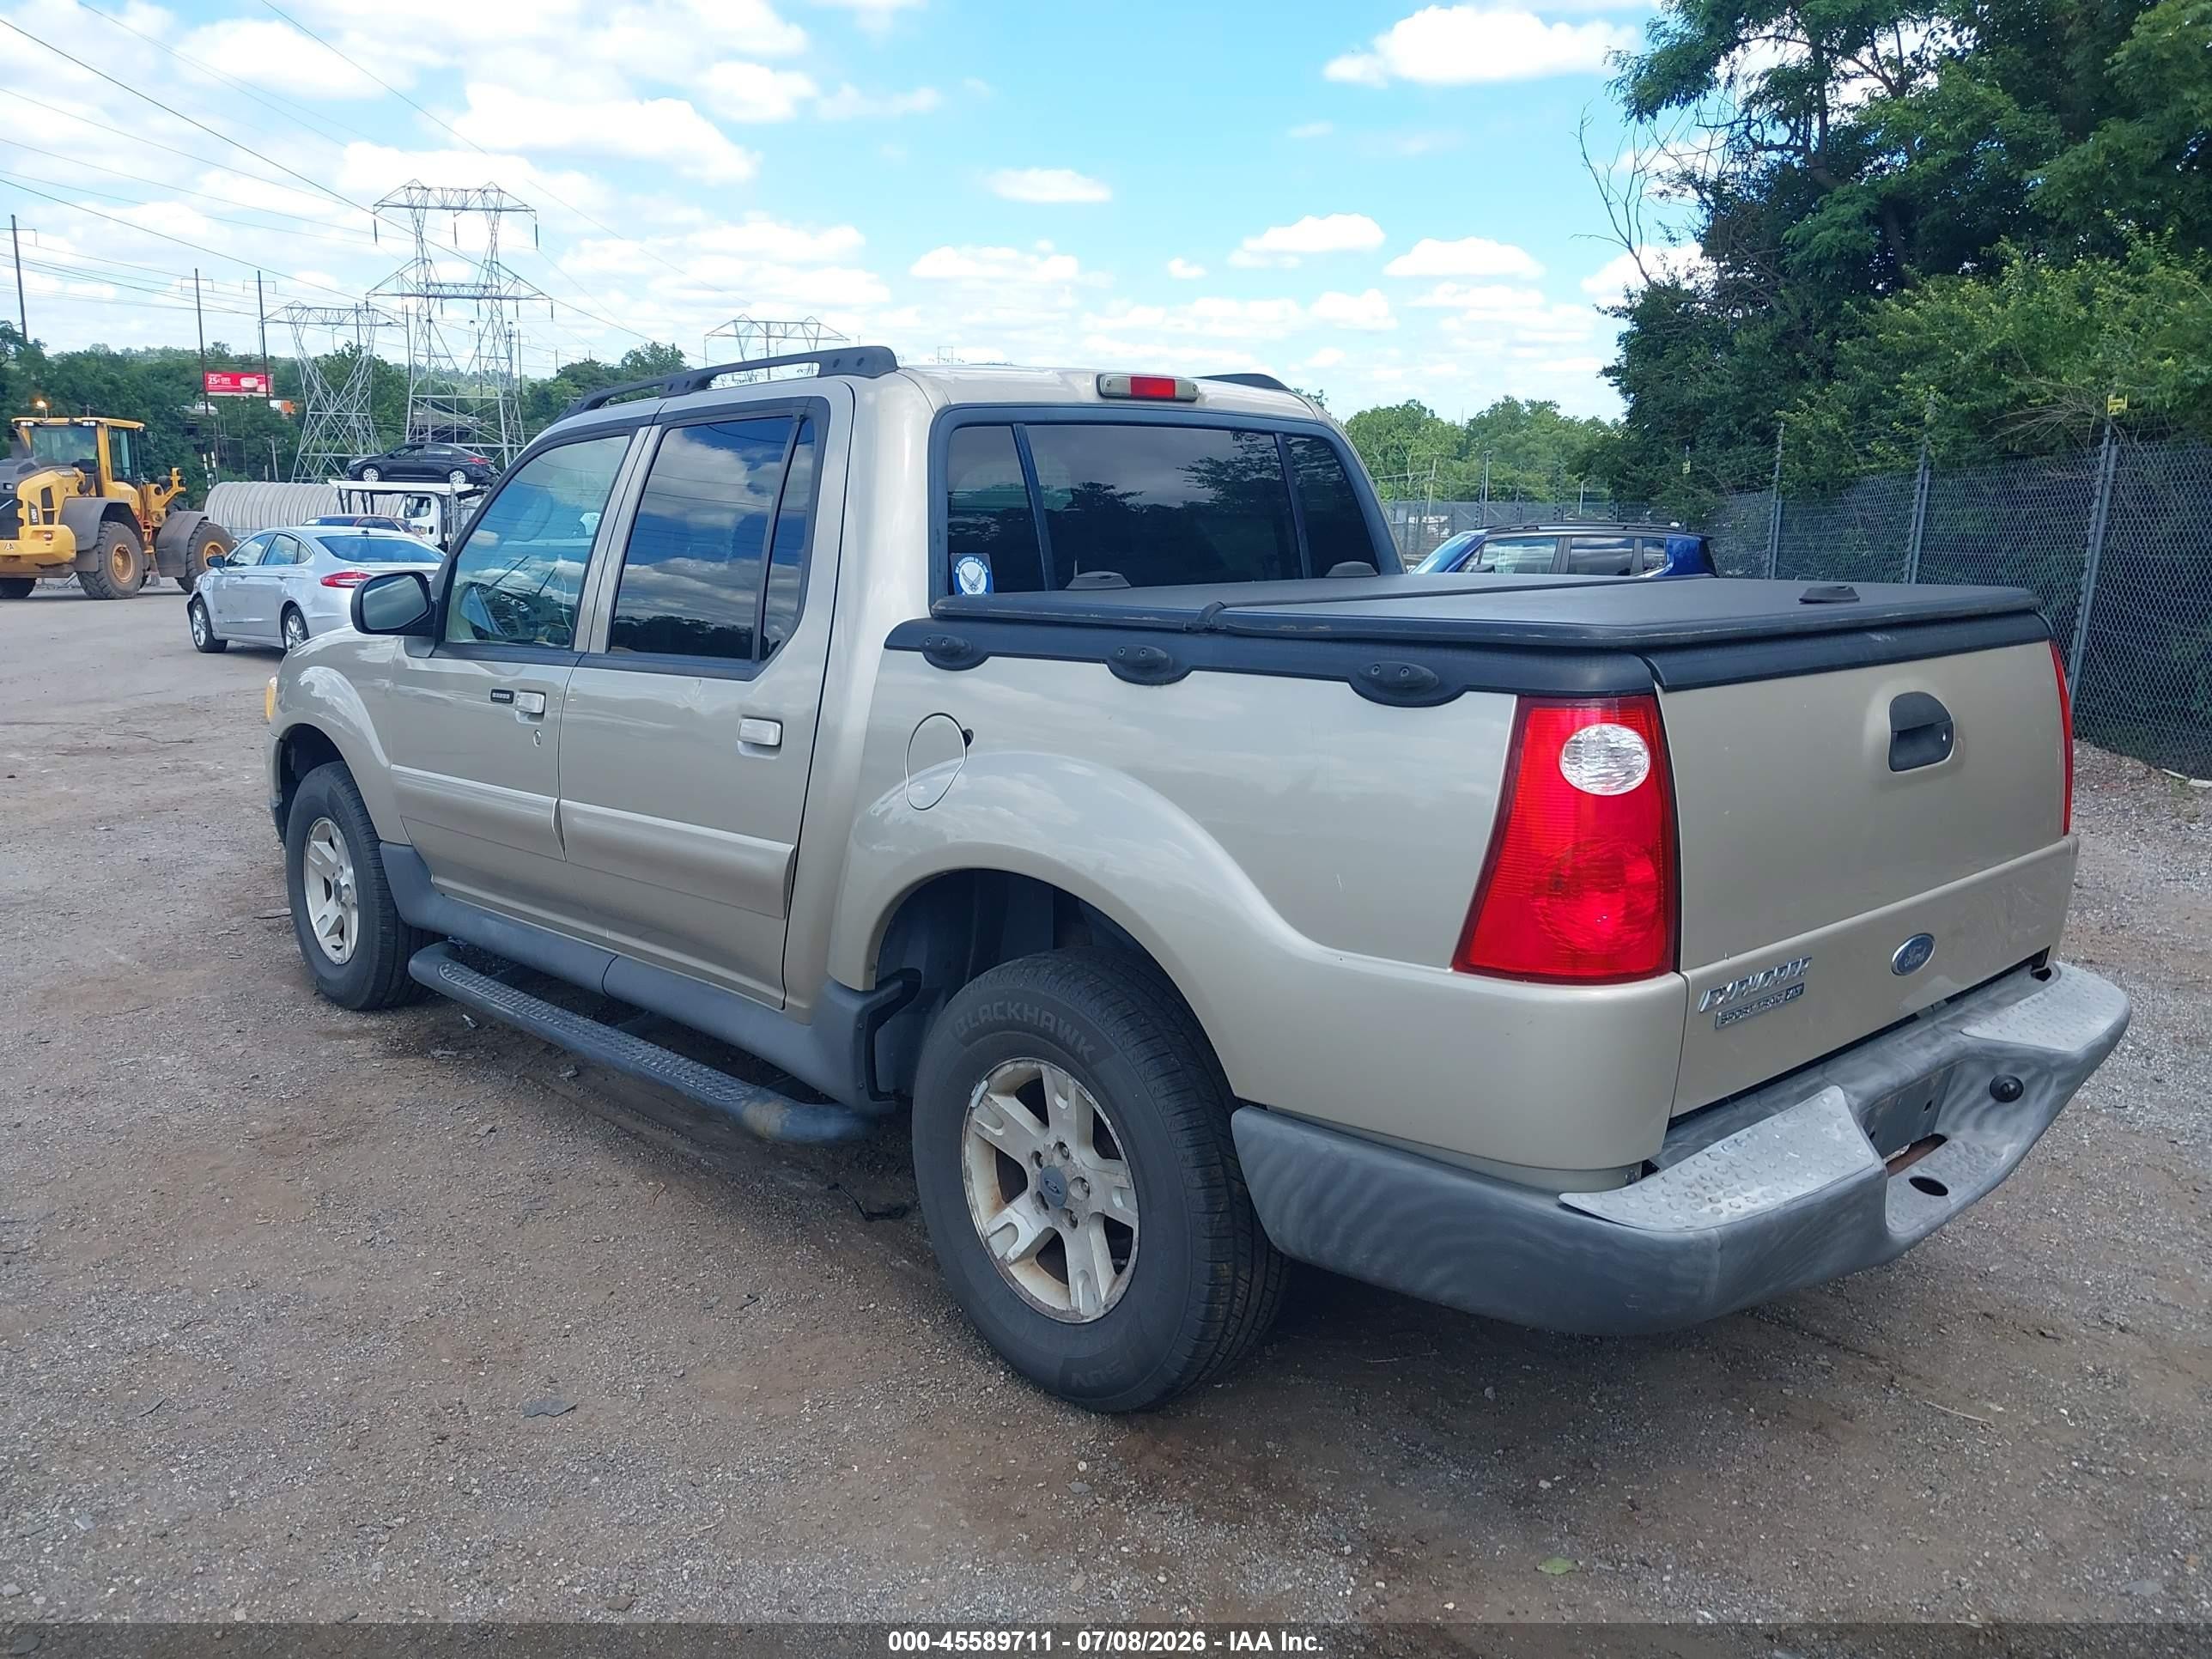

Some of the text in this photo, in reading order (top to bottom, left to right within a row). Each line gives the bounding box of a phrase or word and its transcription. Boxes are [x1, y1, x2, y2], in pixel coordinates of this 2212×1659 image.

[954, 1000, 1097, 1064] BLACKHAWK
[1720, 1004, 1753, 1024] SPORT
[1756, 993, 1784, 1012] TRAC
